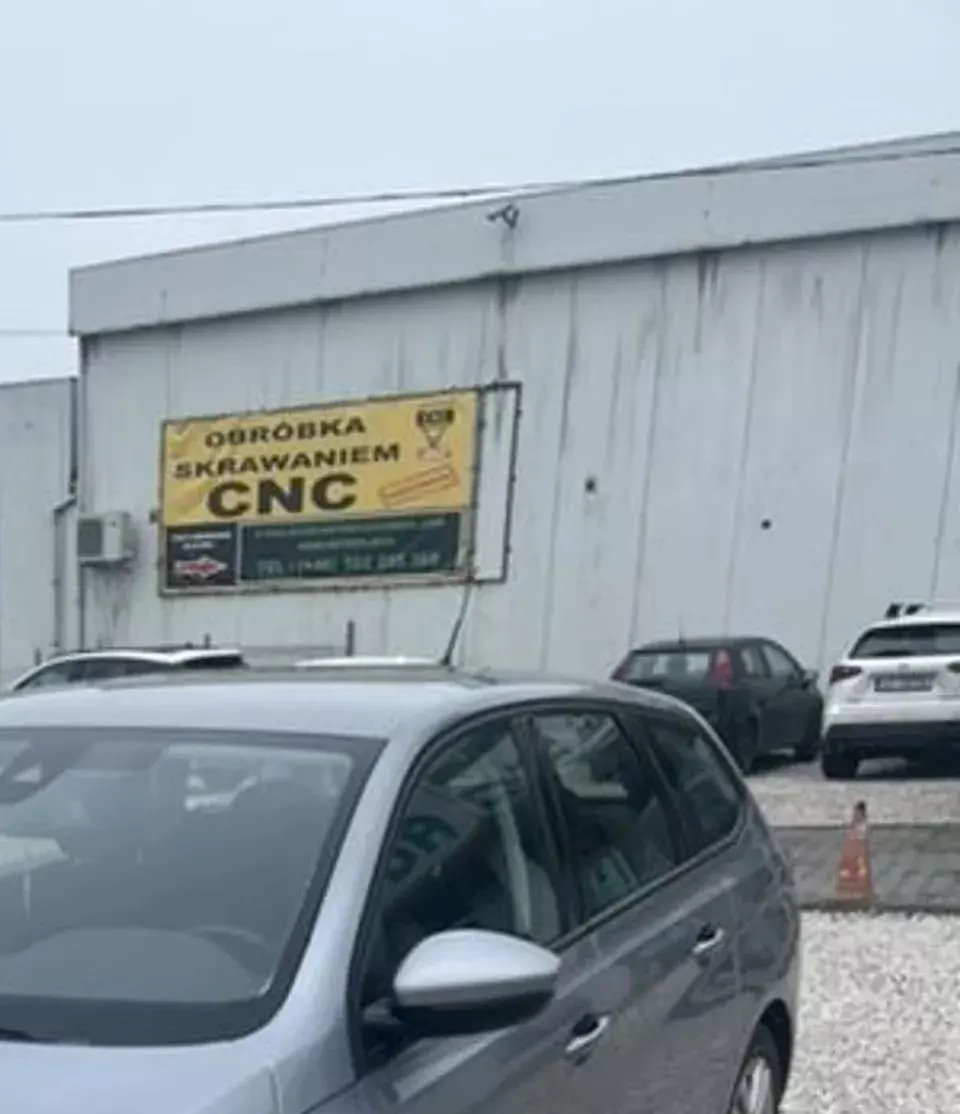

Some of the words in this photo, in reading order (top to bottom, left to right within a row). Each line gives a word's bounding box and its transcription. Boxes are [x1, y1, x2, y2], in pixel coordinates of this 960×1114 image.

[205, 416, 367, 449] OBRÓBKA
[174, 443, 400, 479] SKRAWANIEM
[206, 472, 358, 519] CNC
